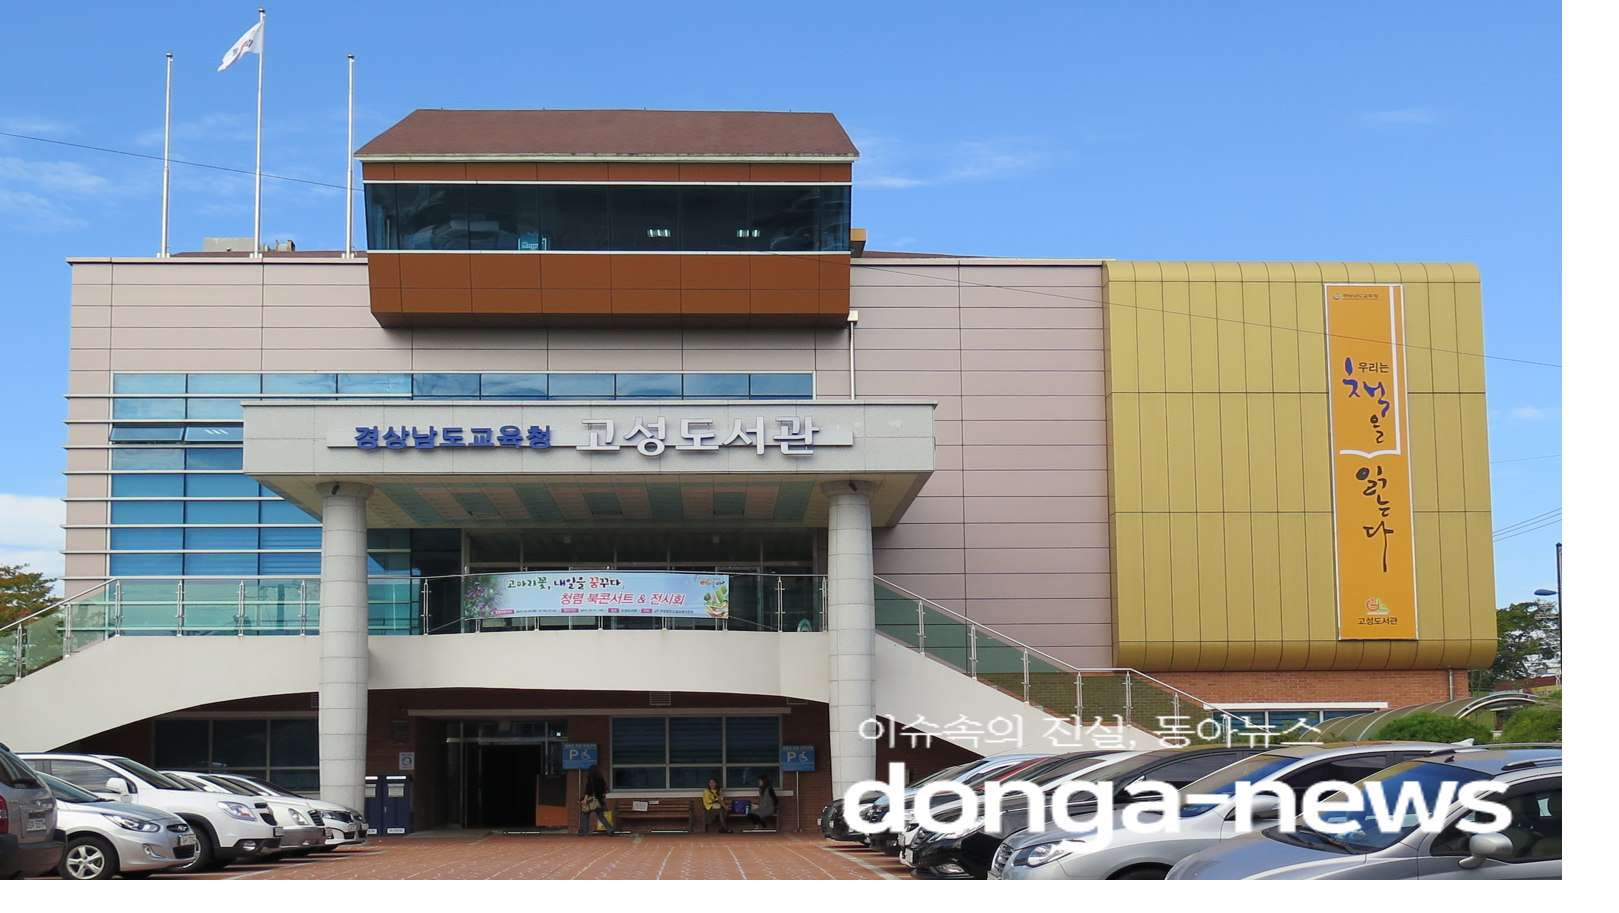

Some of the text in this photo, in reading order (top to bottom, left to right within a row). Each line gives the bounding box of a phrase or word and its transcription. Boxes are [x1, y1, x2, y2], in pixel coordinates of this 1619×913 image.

[1358, 362, 1389, 373] 우리는
[354, 415, 821, 456] 경상남도교육청 고성도서관
[1356, 465, 1394, 573] 읽는다
[554, 576, 586, 590] 내일을
[561, 592, 686, 606] 청렴 북콘서트 & 전시회
[1357, 617, 1398, 626] 고성도서관
[569, 749, 579, 760] P
[787, 751, 797, 763] P
